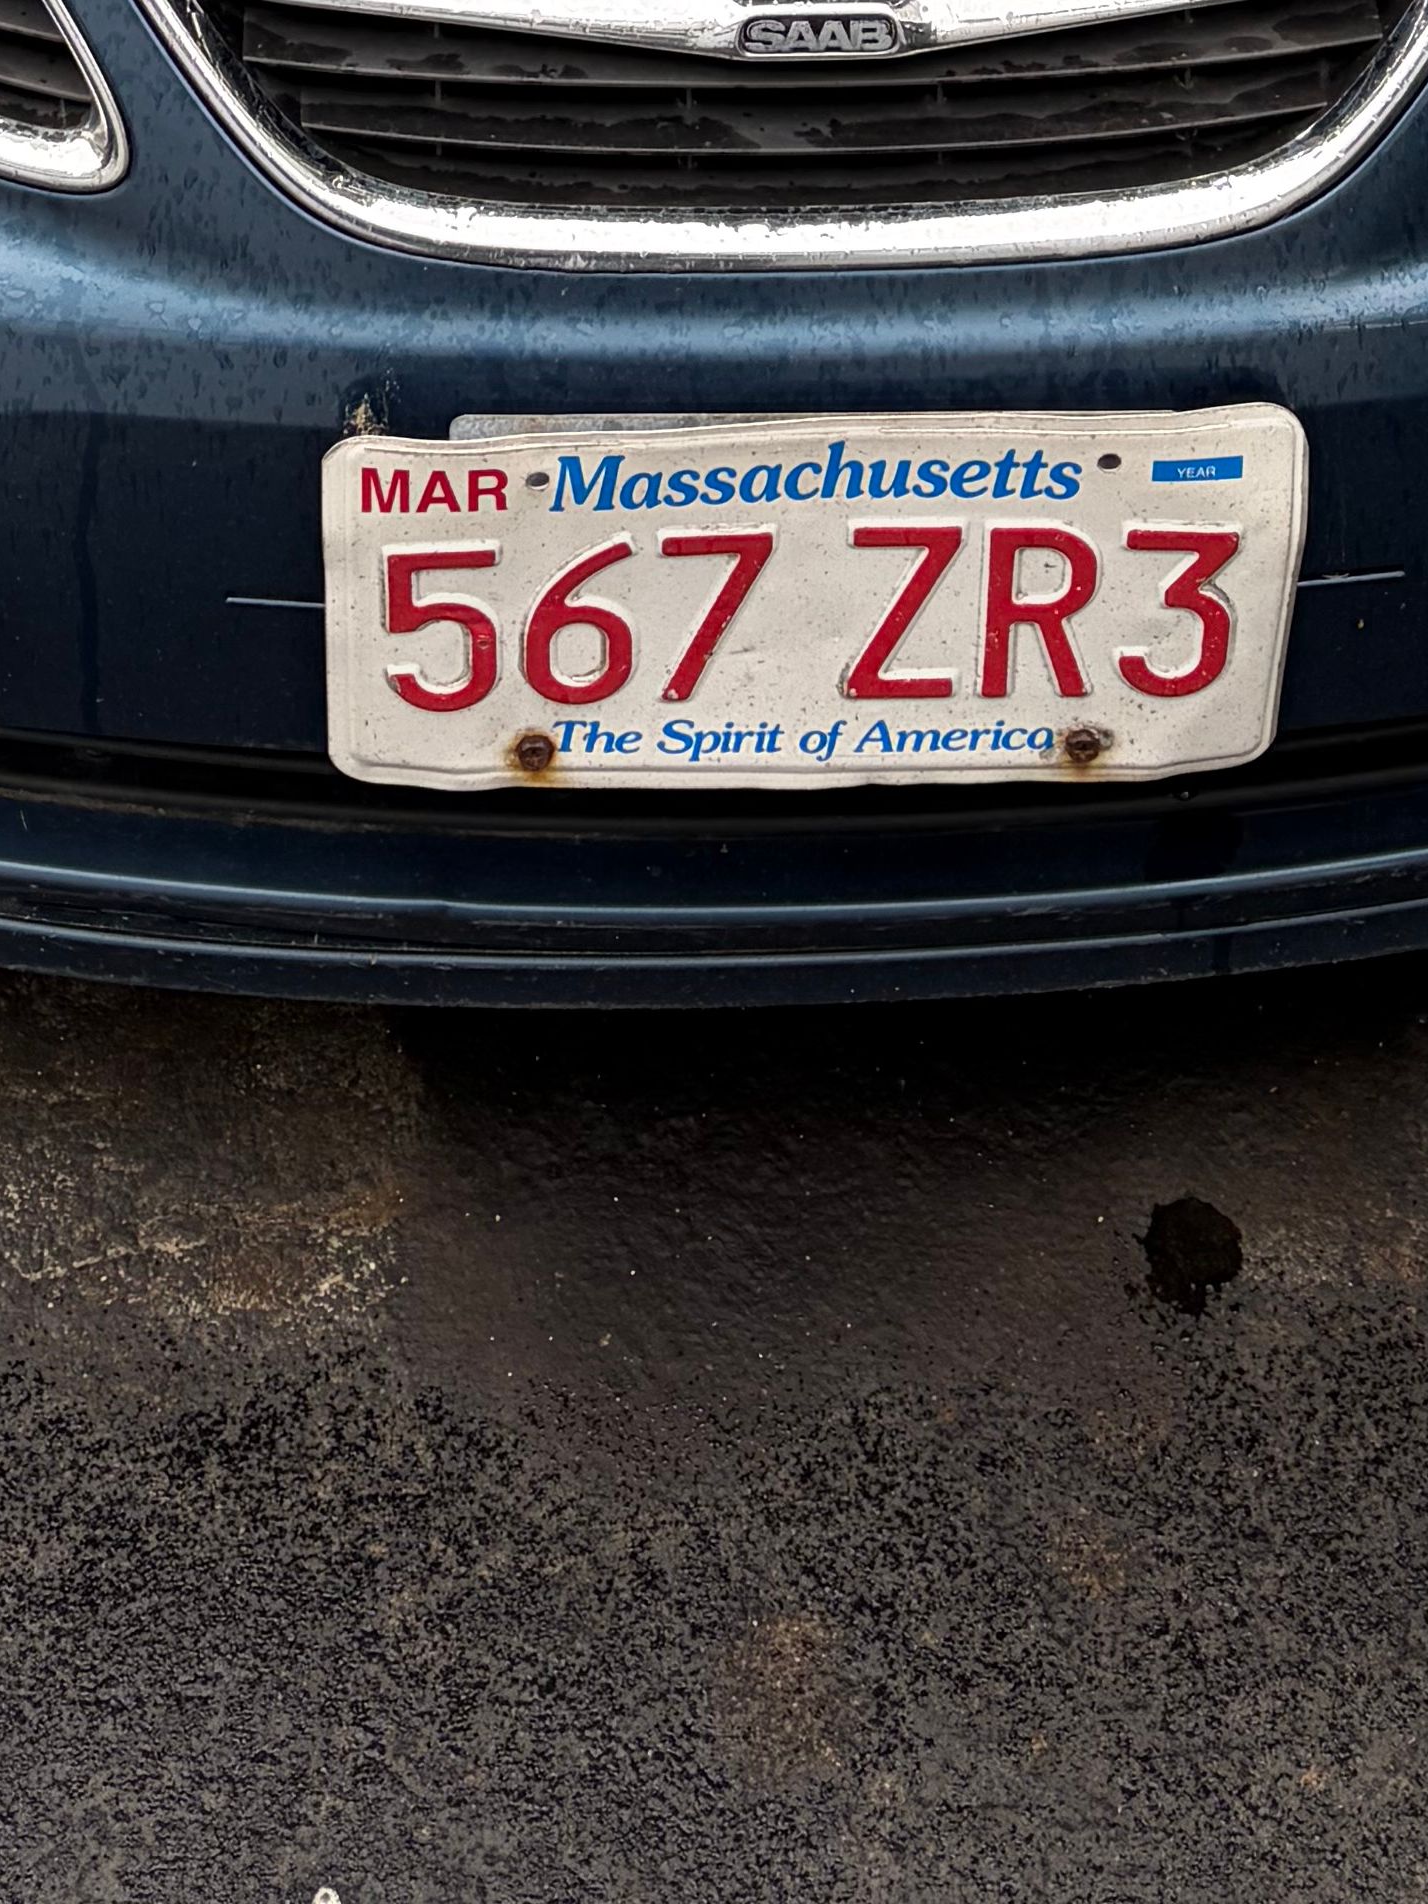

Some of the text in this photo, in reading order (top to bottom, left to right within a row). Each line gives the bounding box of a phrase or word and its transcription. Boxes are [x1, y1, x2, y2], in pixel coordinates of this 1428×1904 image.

[745, 18, 894, 53] SAAB
[361, 467, 508, 513] MAR
[548, 440, 1083, 512] Massachusetts
[1177, 465, 1217, 479] YEAR
[385, 524, 1240, 712] 567 ZR3
[552, 719, 1055, 763] The Spirit of America
